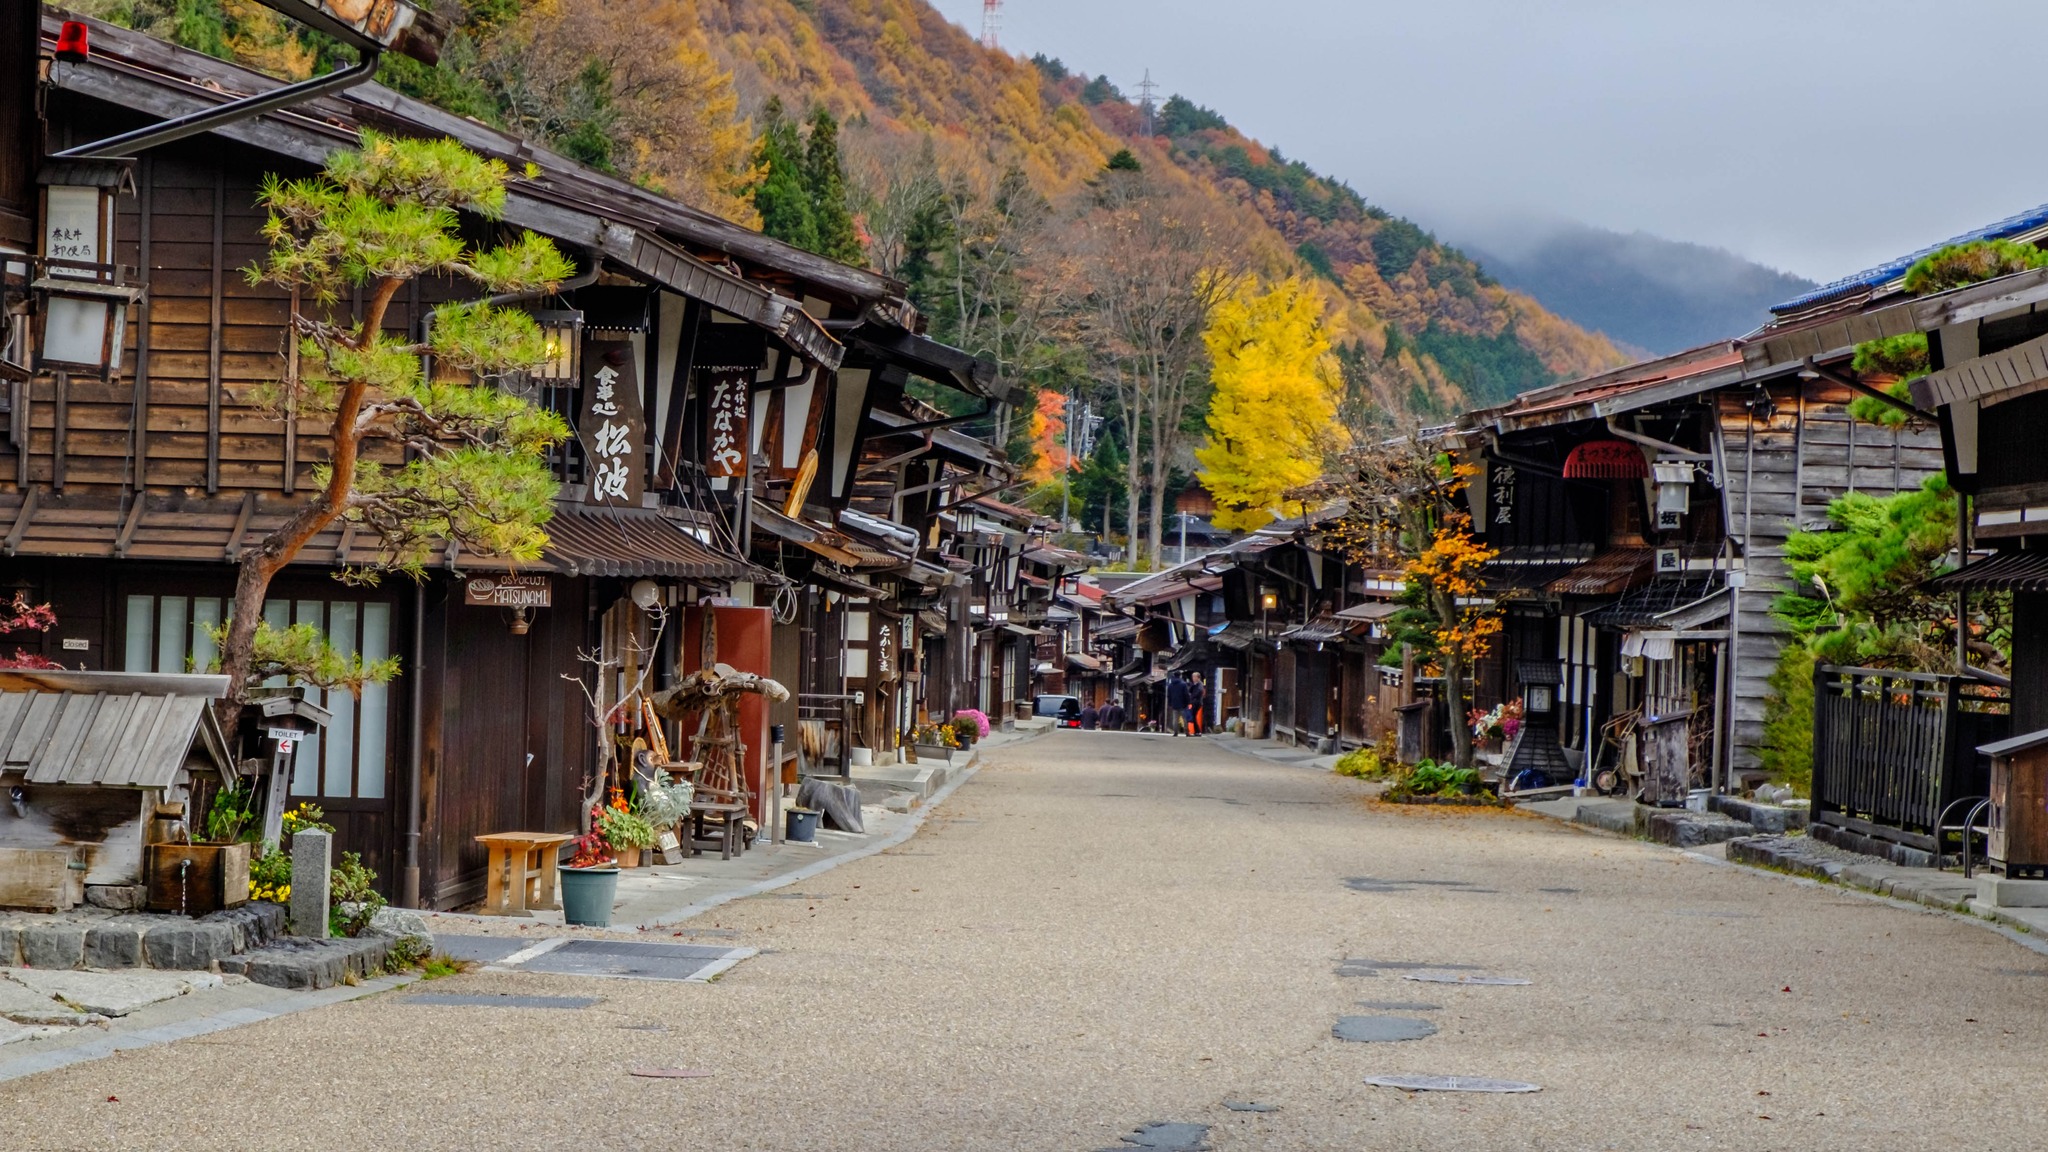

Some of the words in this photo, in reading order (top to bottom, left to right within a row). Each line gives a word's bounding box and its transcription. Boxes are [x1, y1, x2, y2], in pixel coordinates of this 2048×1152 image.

[51, 227, 82, 241] 奈良井
[711, 380, 742, 475] たなかや
[1493, 465, 1516, 524] 徳利屋
[500, 575, 546, 586] OSYOKUJI
[494, 589, 547, 605] MATSUNAMI
[879, 624, 891, 672] たかしま
[274, 730, 298, 739] TOILET
